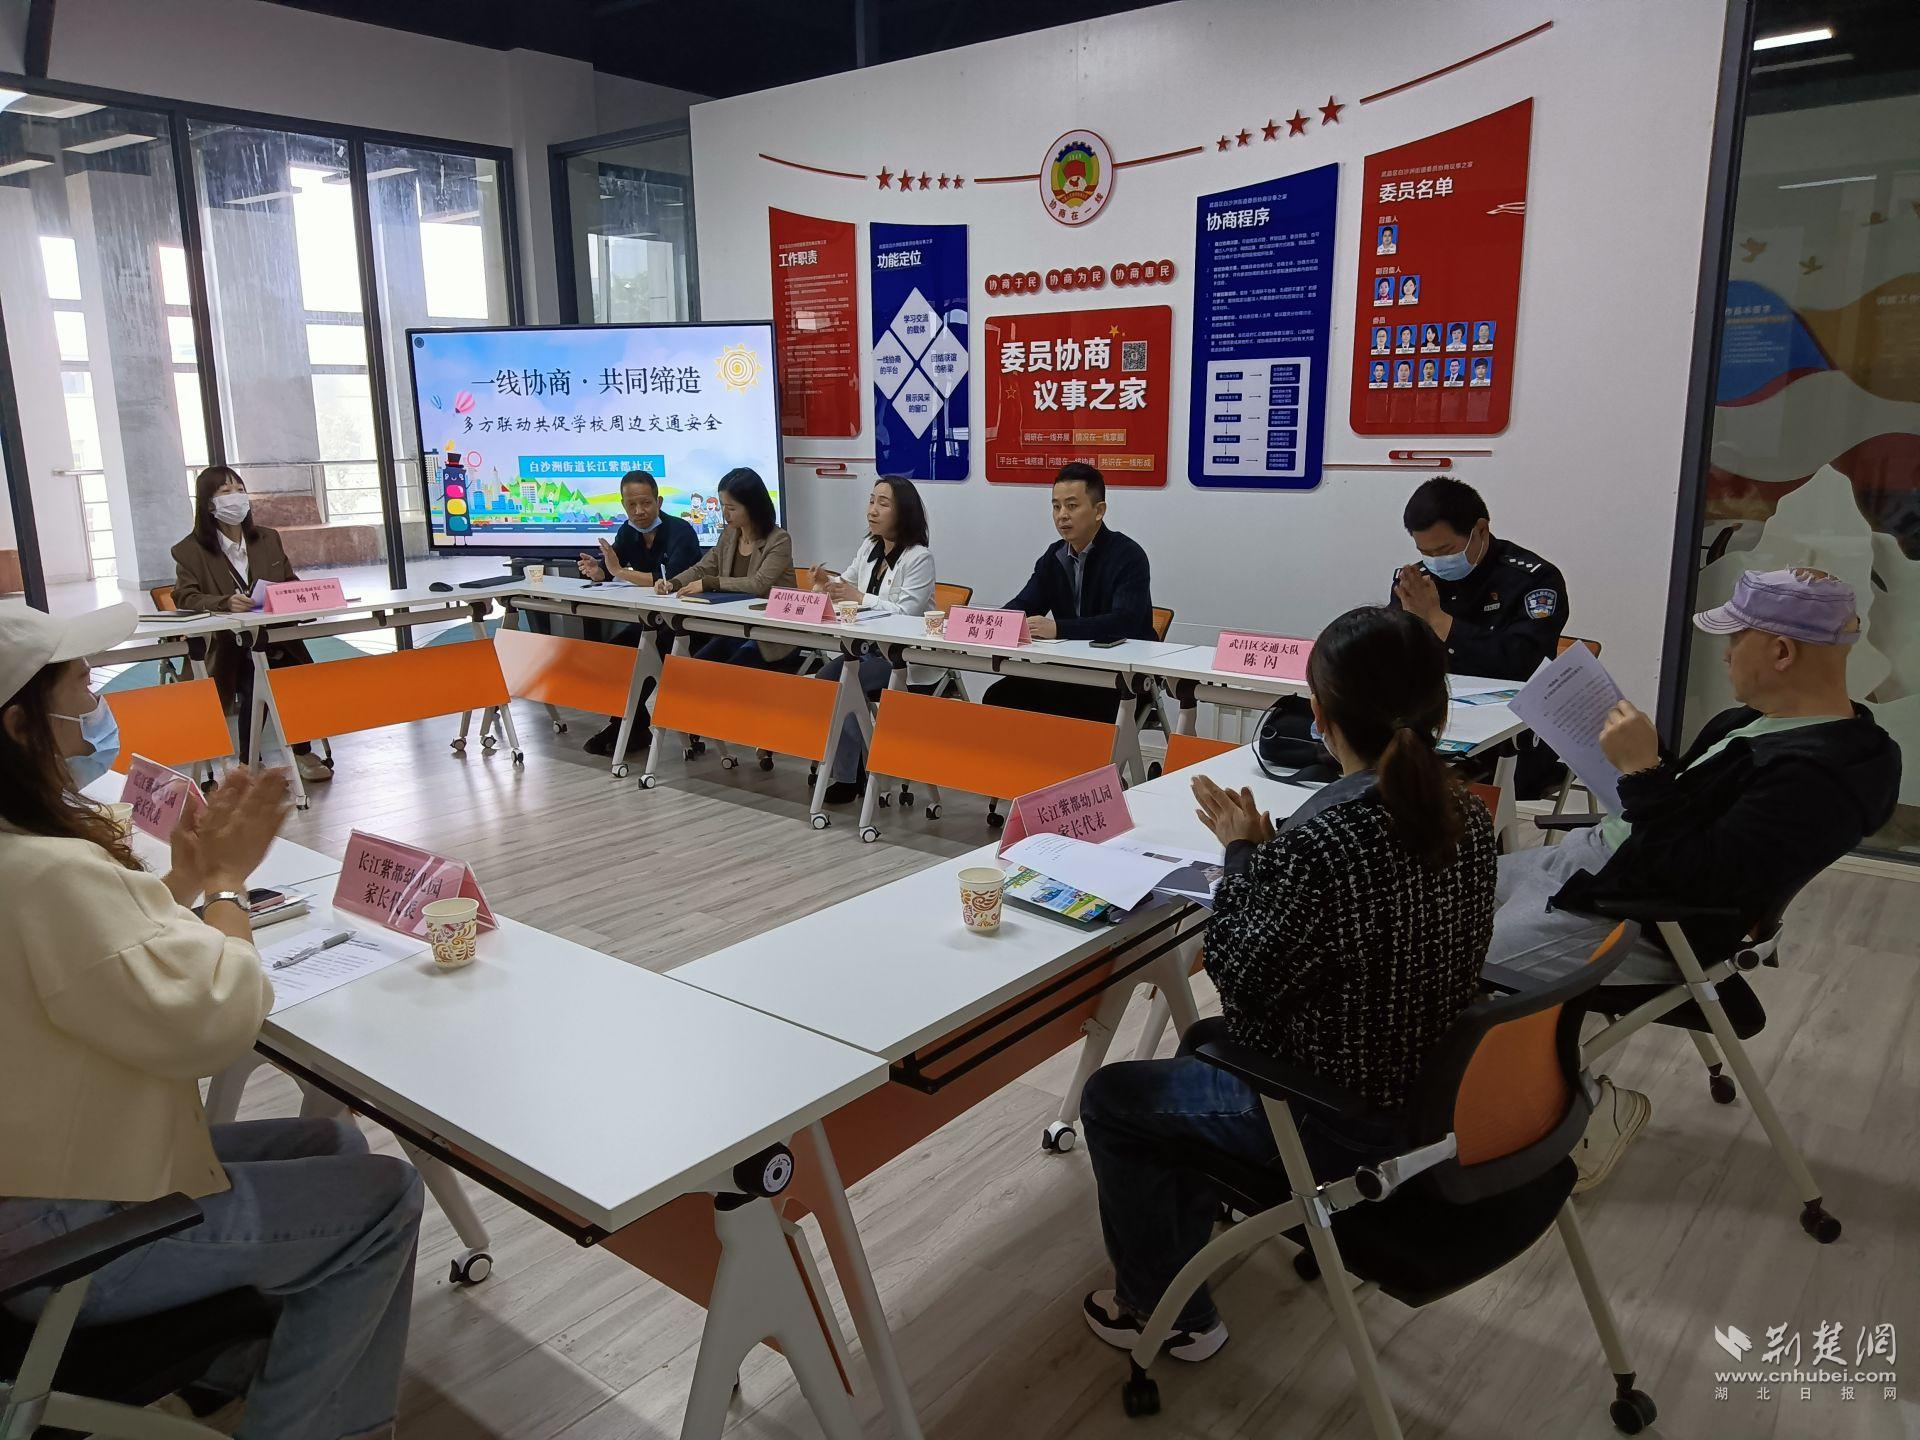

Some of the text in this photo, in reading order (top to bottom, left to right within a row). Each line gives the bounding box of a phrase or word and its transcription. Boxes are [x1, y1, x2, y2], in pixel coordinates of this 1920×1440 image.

[1379, 176, 1453, 203] 委员名单
[1206, 207, 1271, 231] 协商程序
[778, 250, 818, 268] 工作职责
[877, 250, 922, 269] 功能定位
[988, 265, 1170, 291] 协商于民 协商为民 协商惠民
[903, 314, 929, 323] 学习交流
[1000, 337, 1111, 374] 委员协商
[1033, 377, 1148, 412] 议事之家
[462, 413, 723, 434] 多方联动共促学校周边交通安全
[965, 613, 1003, 627] 政协委员
[1229, 638, 1299, 655] 武昌区交通大队
[1037, 784, 1113, 824] 长江紫都幼儿园
